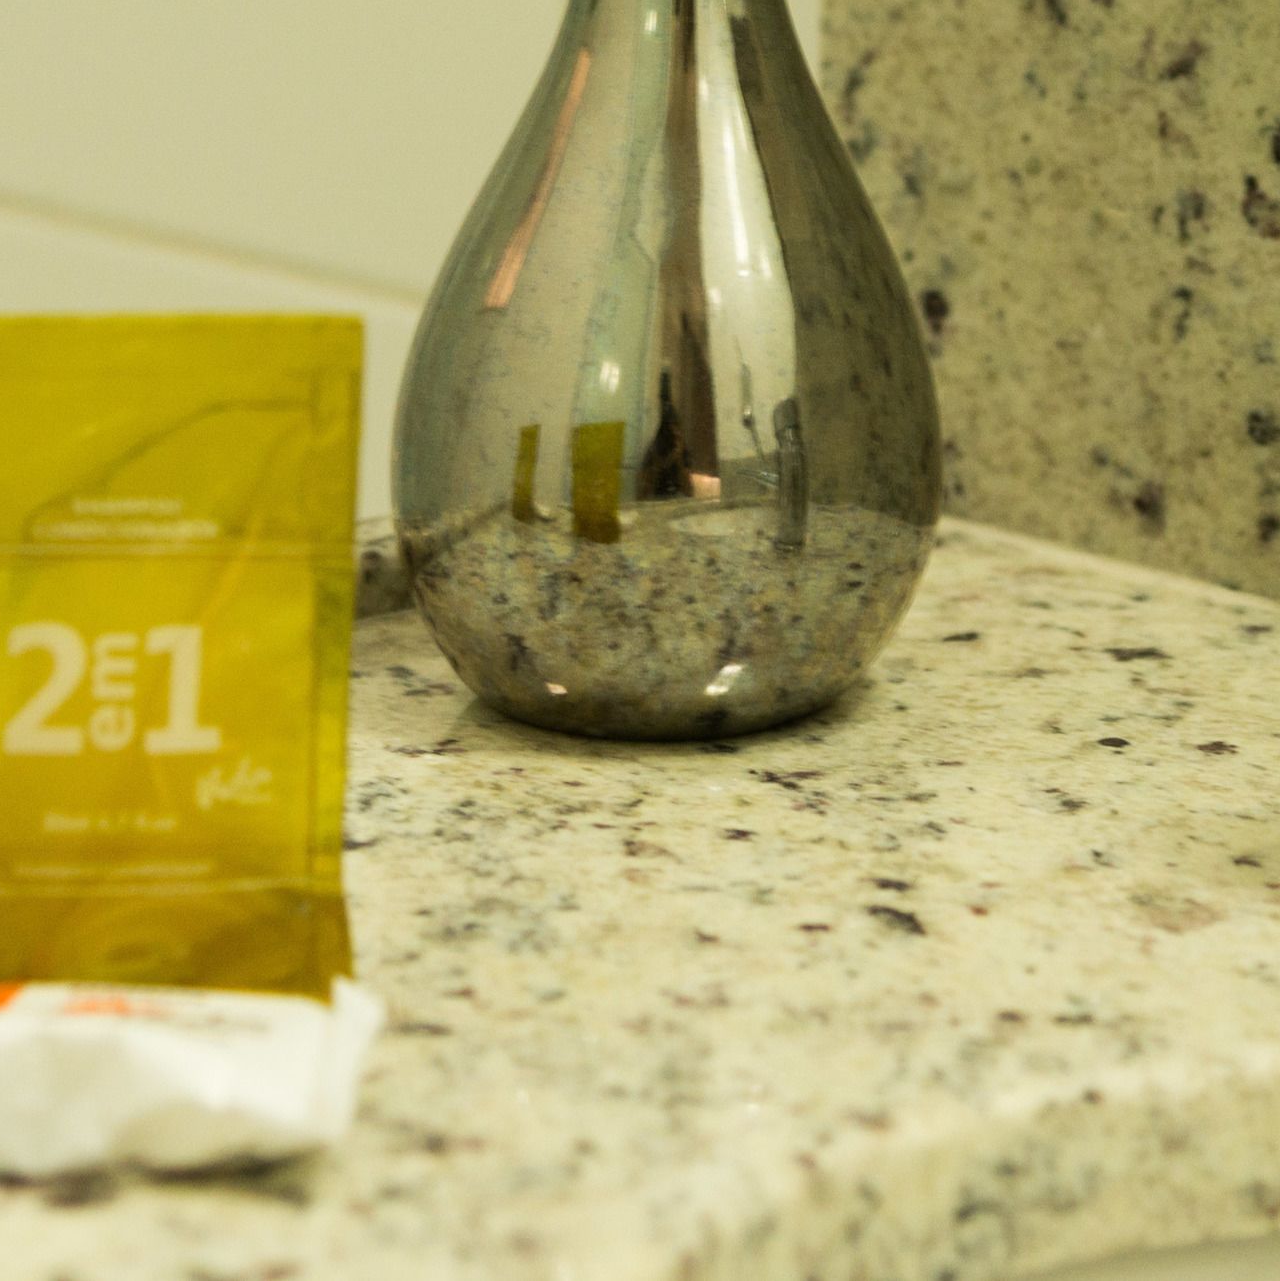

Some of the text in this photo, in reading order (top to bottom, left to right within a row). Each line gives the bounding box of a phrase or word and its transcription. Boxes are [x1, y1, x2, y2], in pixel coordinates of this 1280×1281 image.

[4, 621, 222, 756] 2 em 1
